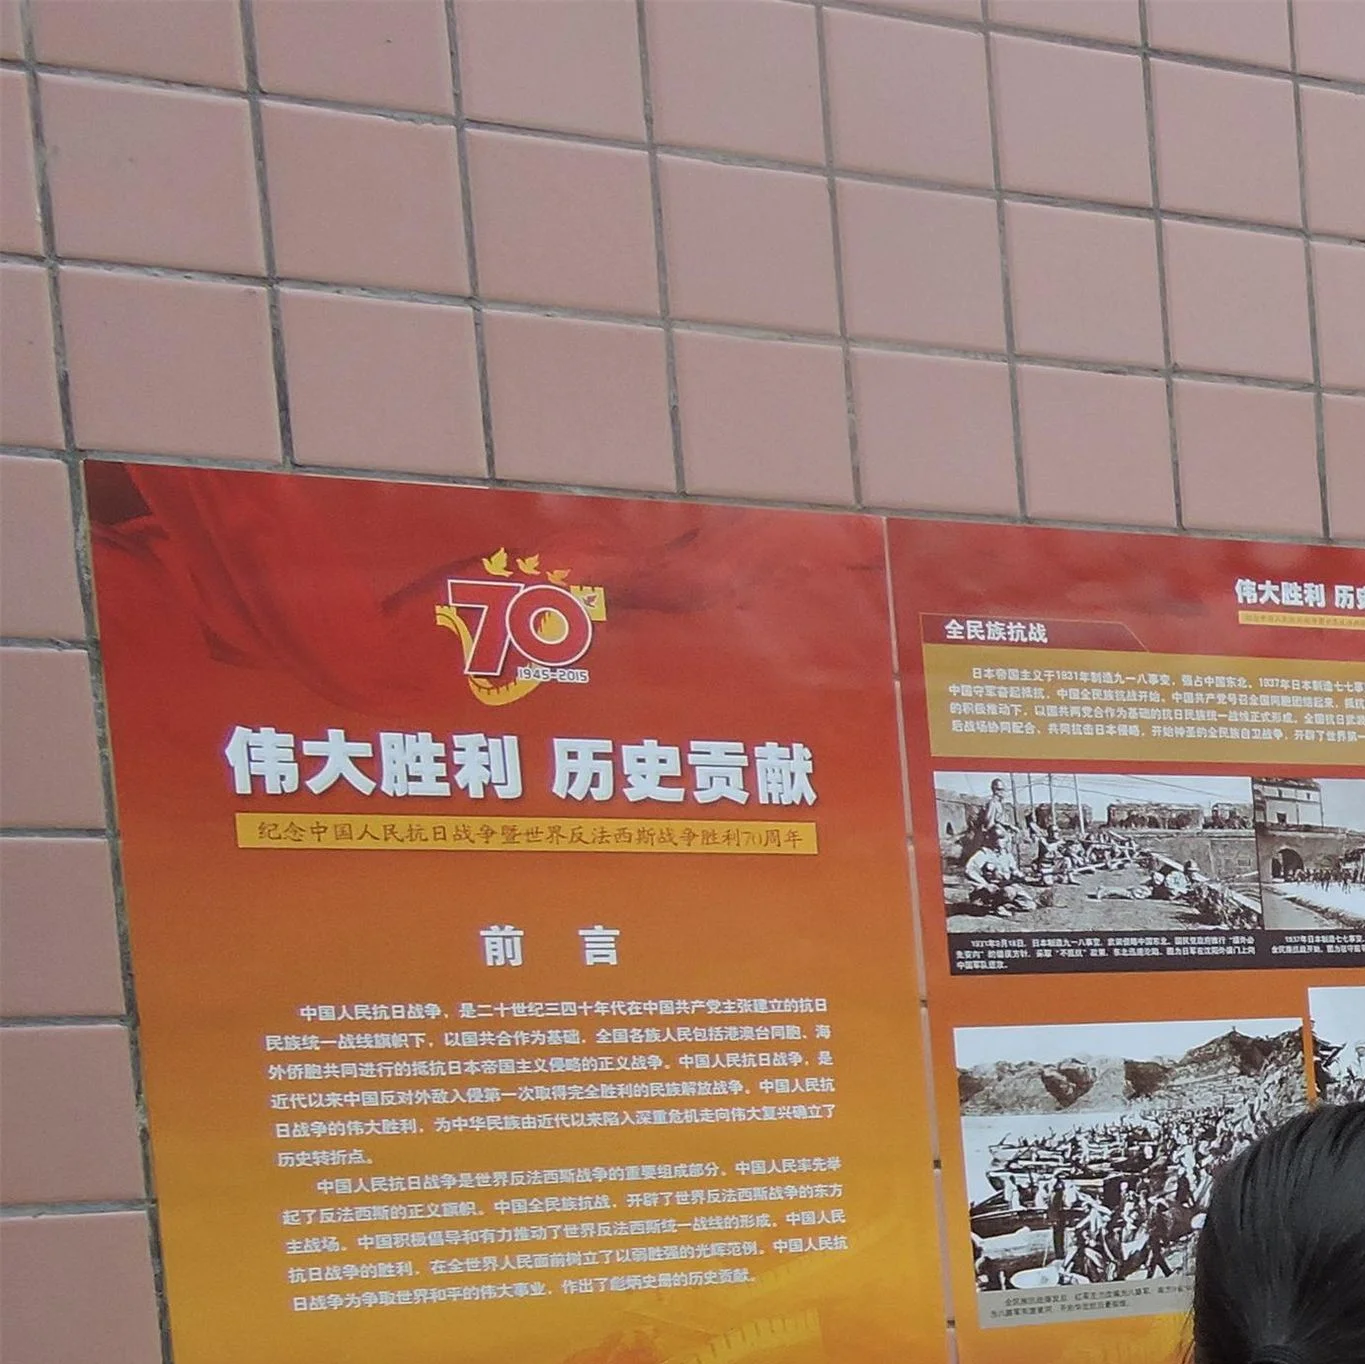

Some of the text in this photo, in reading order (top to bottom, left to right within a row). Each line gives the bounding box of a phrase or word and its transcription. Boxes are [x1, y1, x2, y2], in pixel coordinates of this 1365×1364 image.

[1235, 579, 1325, 608] 伟大胜利
[447, 578, 593, 676] 70
[944, 619, 1048, 644] 全民族抗战
[517, 667, 589, 683] 1945-2015
[226, 725, 818, 806] 伟大胜利 历史贡献
[258, 821, 804, 848] 纪念中国人民抗日战争暨世界反法西斯战争胜利70周年
